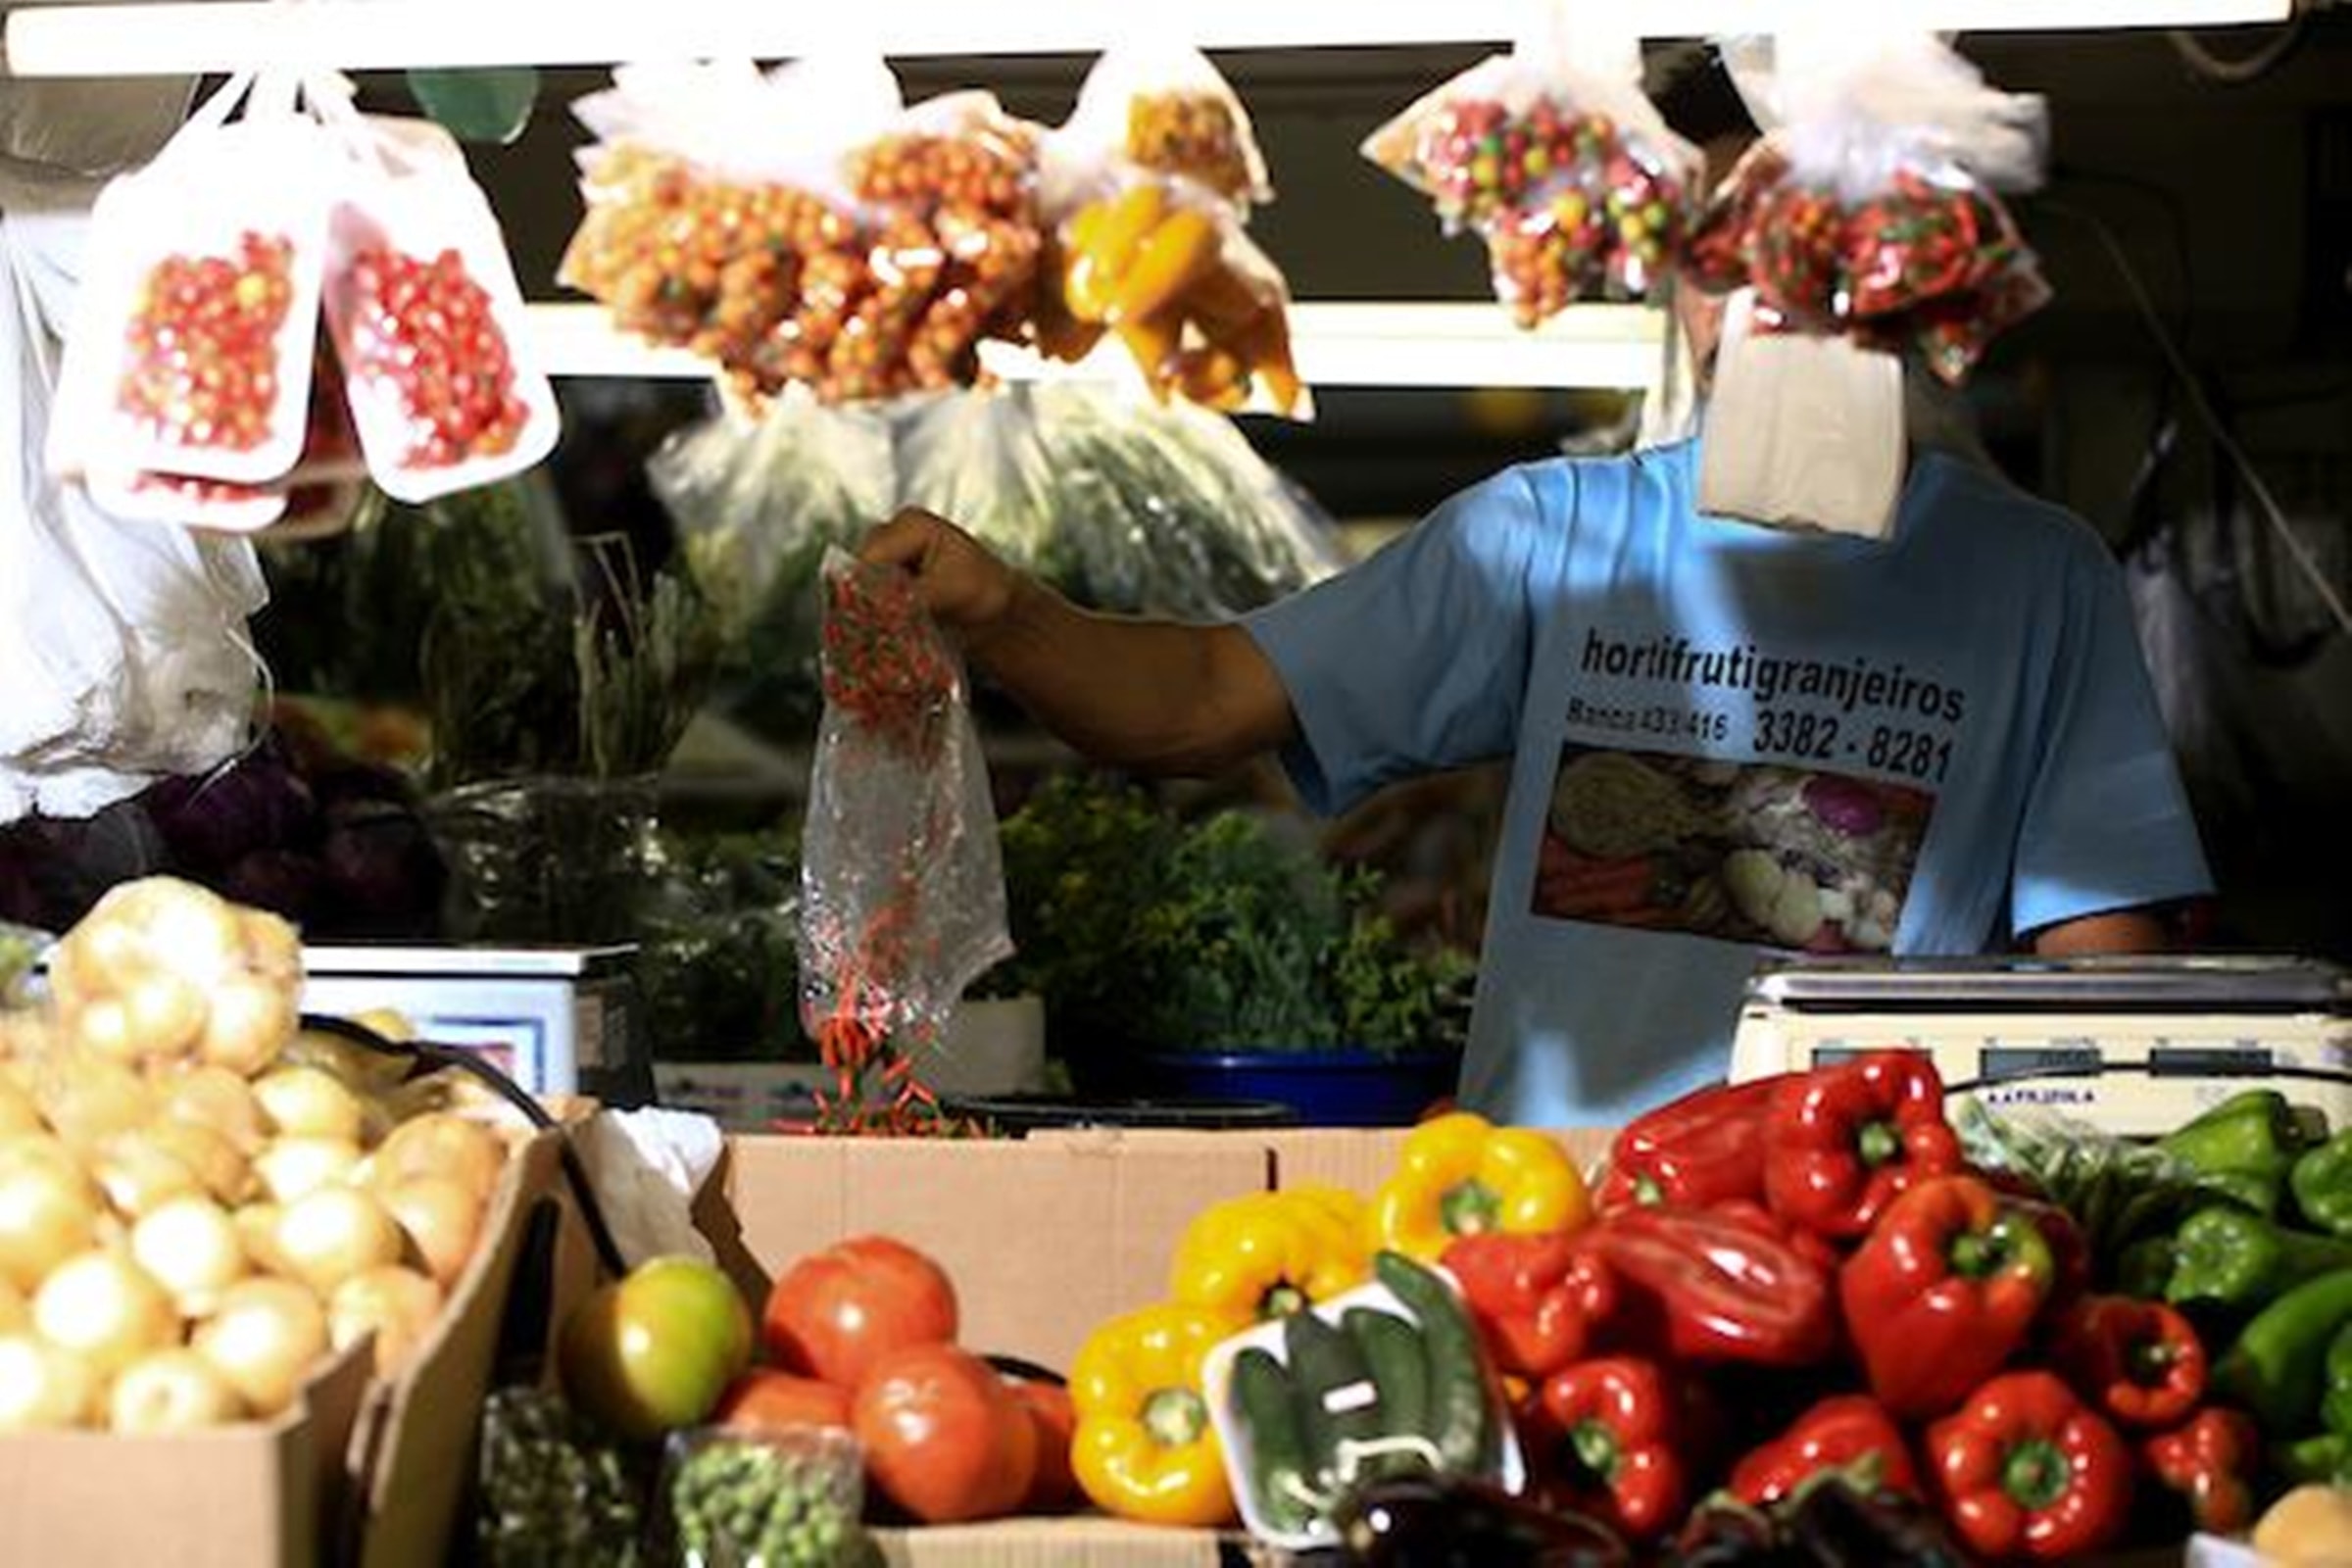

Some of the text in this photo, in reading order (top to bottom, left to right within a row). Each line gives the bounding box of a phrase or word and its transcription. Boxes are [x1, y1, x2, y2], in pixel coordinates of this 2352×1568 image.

[1582, 627, 1966, 722] hortifrutigranjeiros
[1754, 710, 1839, 760] 3382
[1868, 726, 1952, 782] 8281
